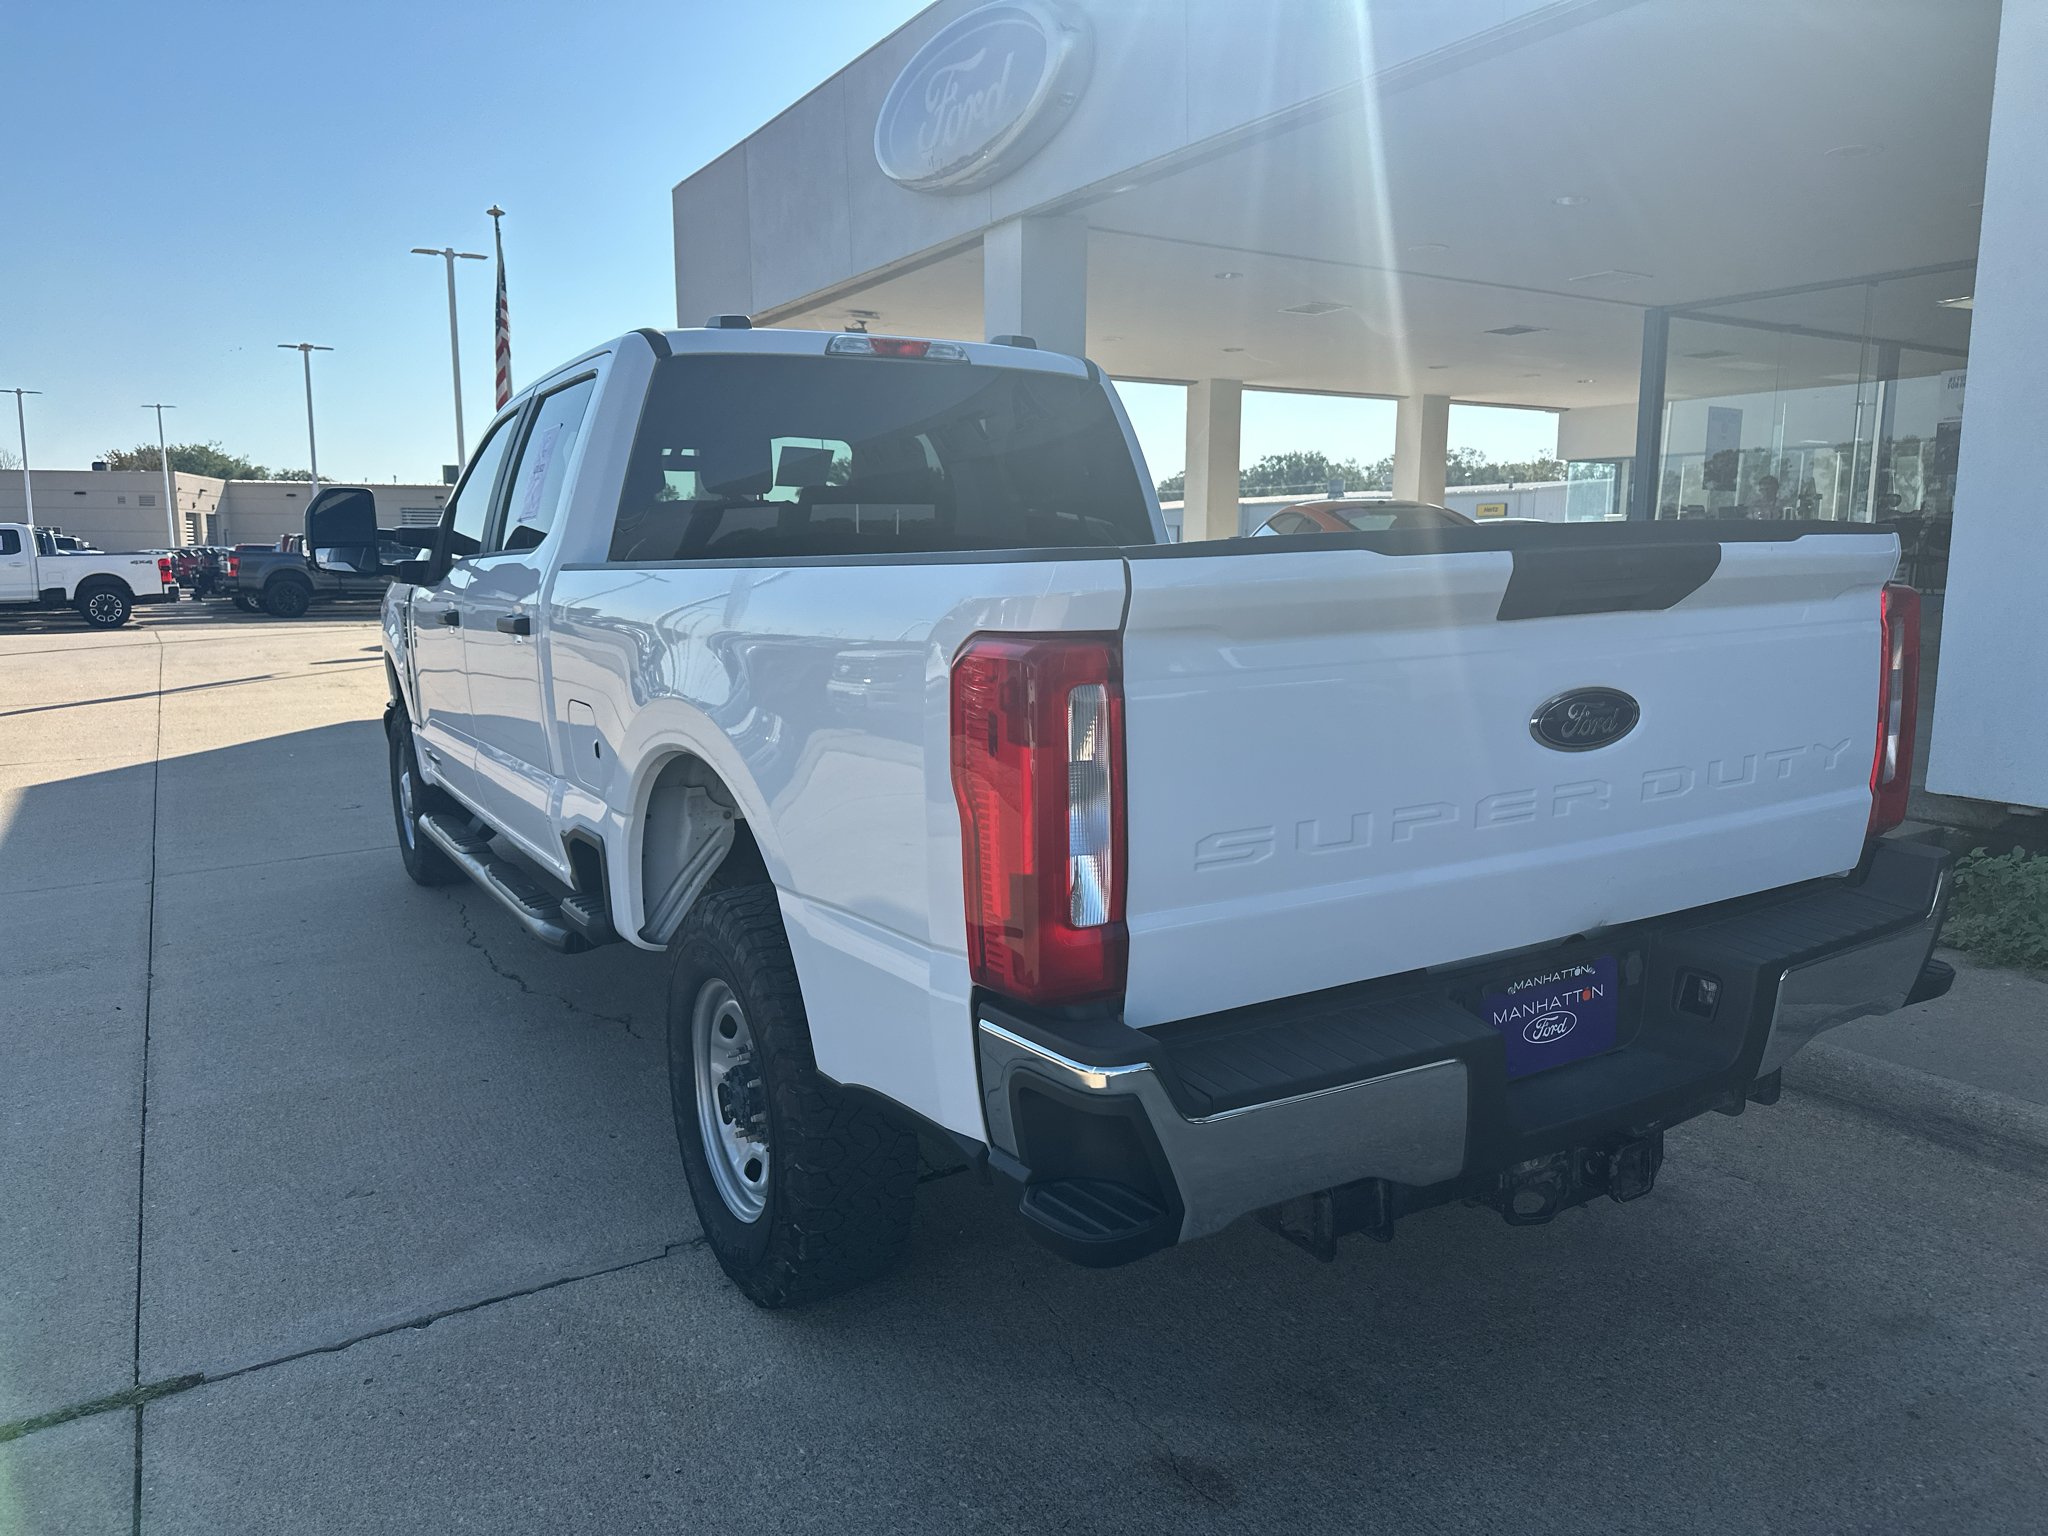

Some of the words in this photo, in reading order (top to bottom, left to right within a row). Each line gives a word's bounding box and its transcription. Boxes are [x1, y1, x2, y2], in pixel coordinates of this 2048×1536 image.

[917, 47, 1016, 155] Ford
[1561, 700, 1620, 739] Ford
[1193, 778, 1612, 872] SUPER
[1640, 736, 1852, 803] DUTY
[1532, 1015, 1569, 1040] Ford
